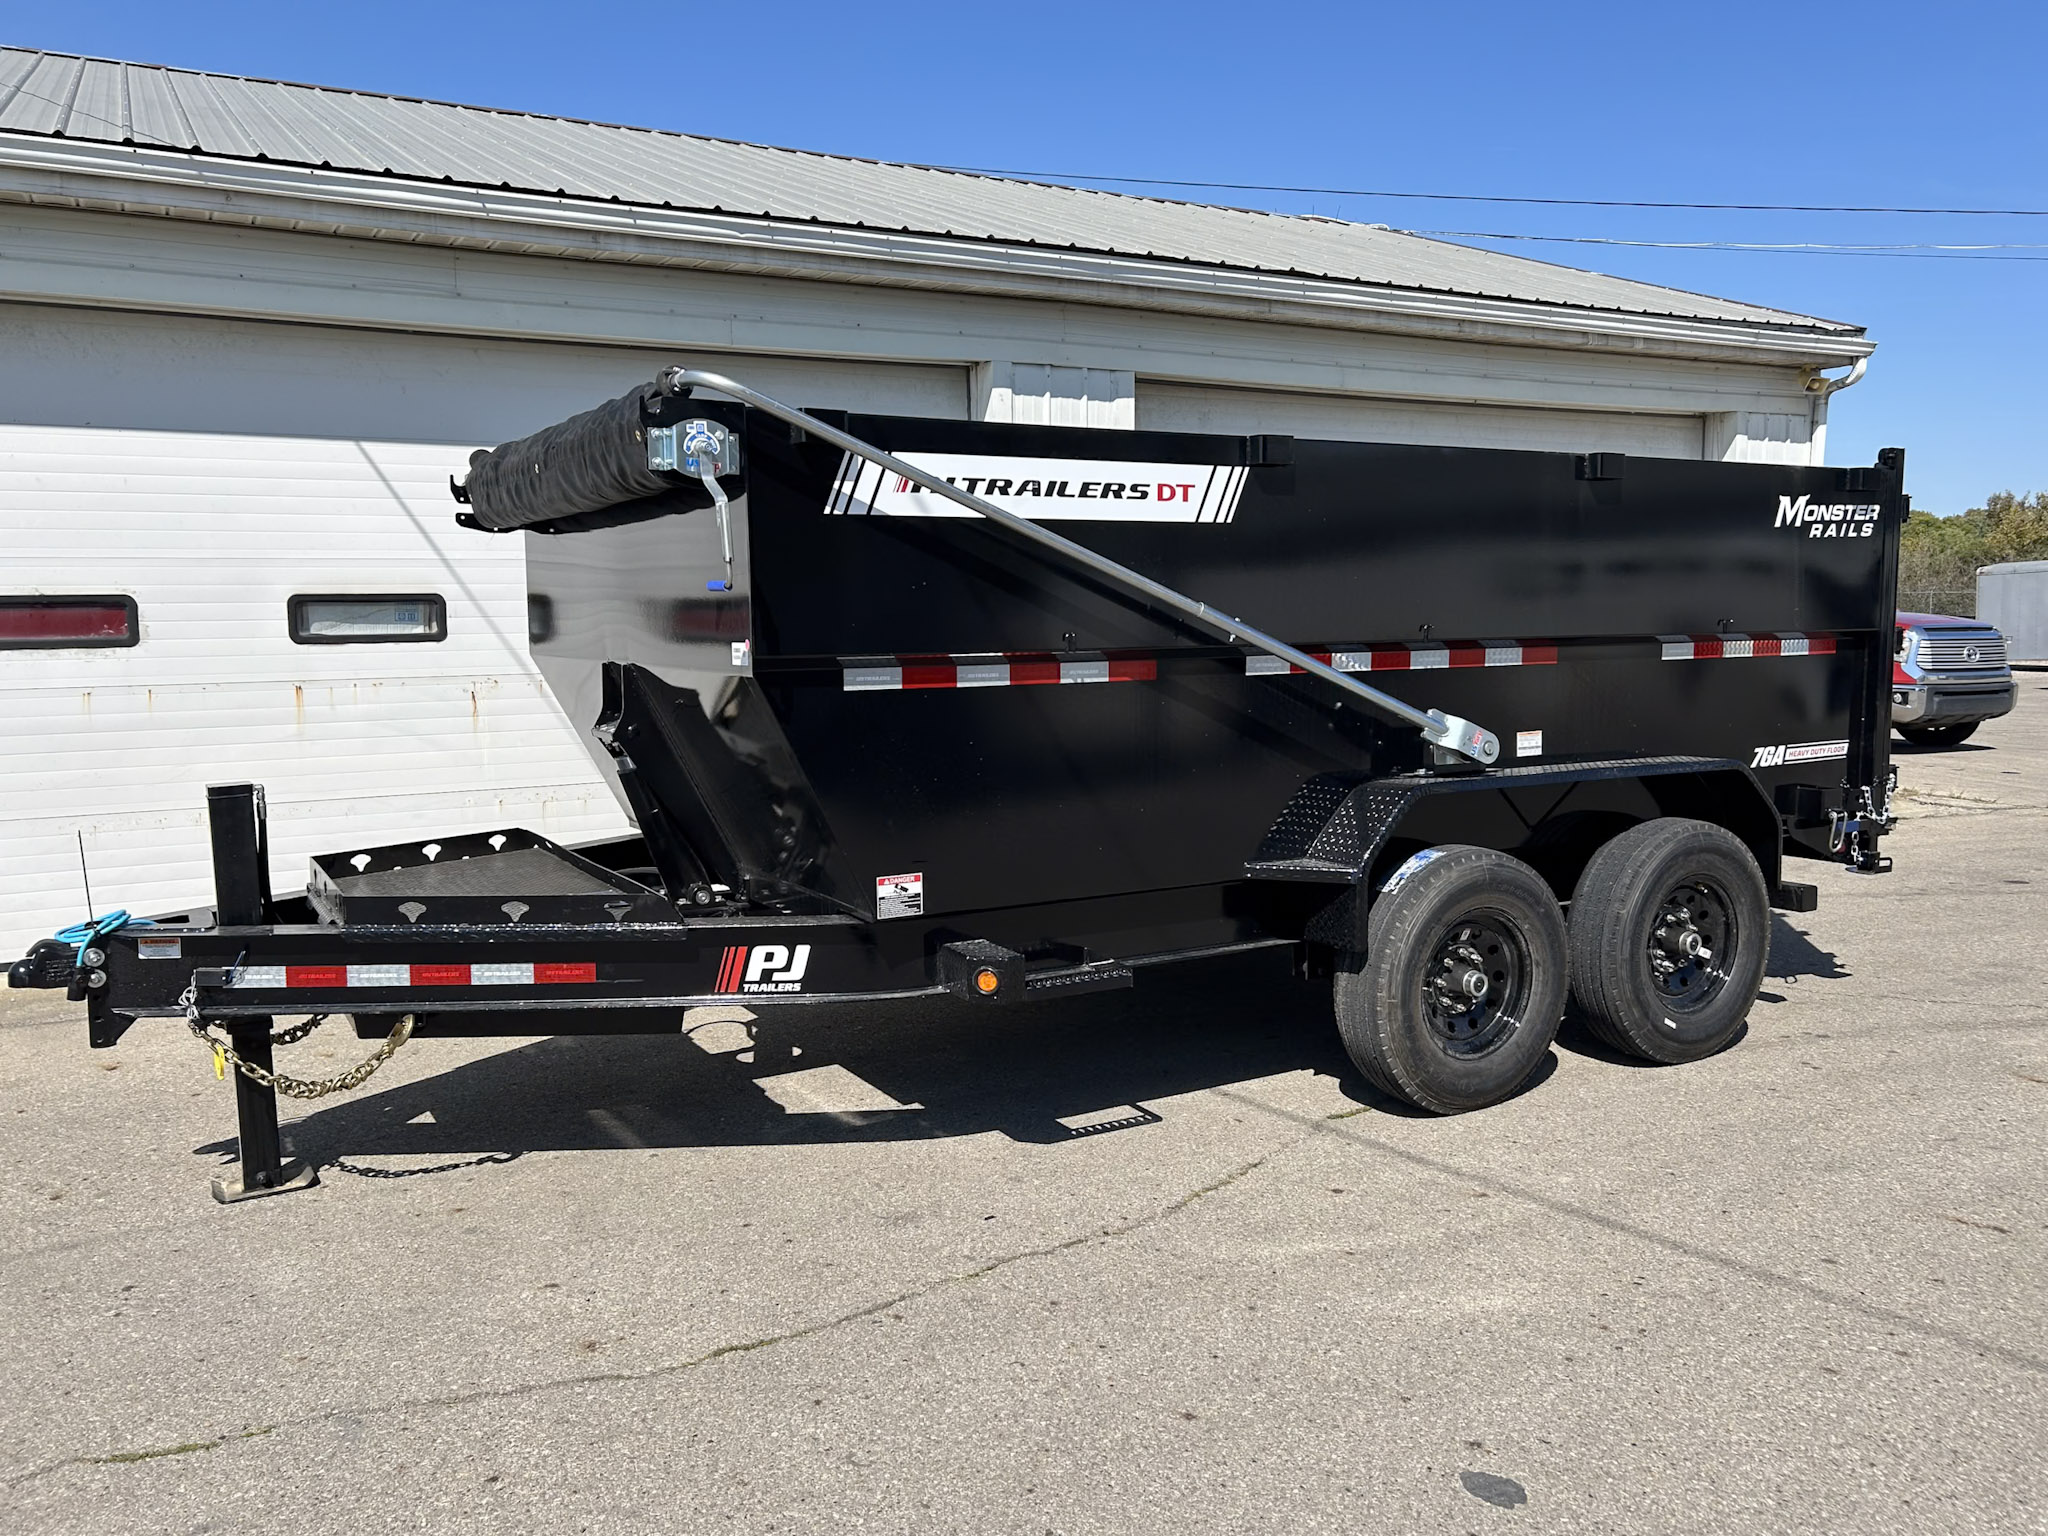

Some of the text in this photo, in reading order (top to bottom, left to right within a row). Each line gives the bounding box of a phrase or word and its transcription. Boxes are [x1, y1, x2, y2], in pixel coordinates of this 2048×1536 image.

[962, 477, 1151, 500] TRAILERS
[1157, 484, 1196, 502] DT
[1809, 523, 1874, 538] RAILS
[1750, 745, 1846, 769] 7GA HEAVY DUTY FLOOR
[890, 875, 915, 885] DANGER
[745, 944, 811, 982] PJ
[742, 982, 802, 993] TRAILERS
